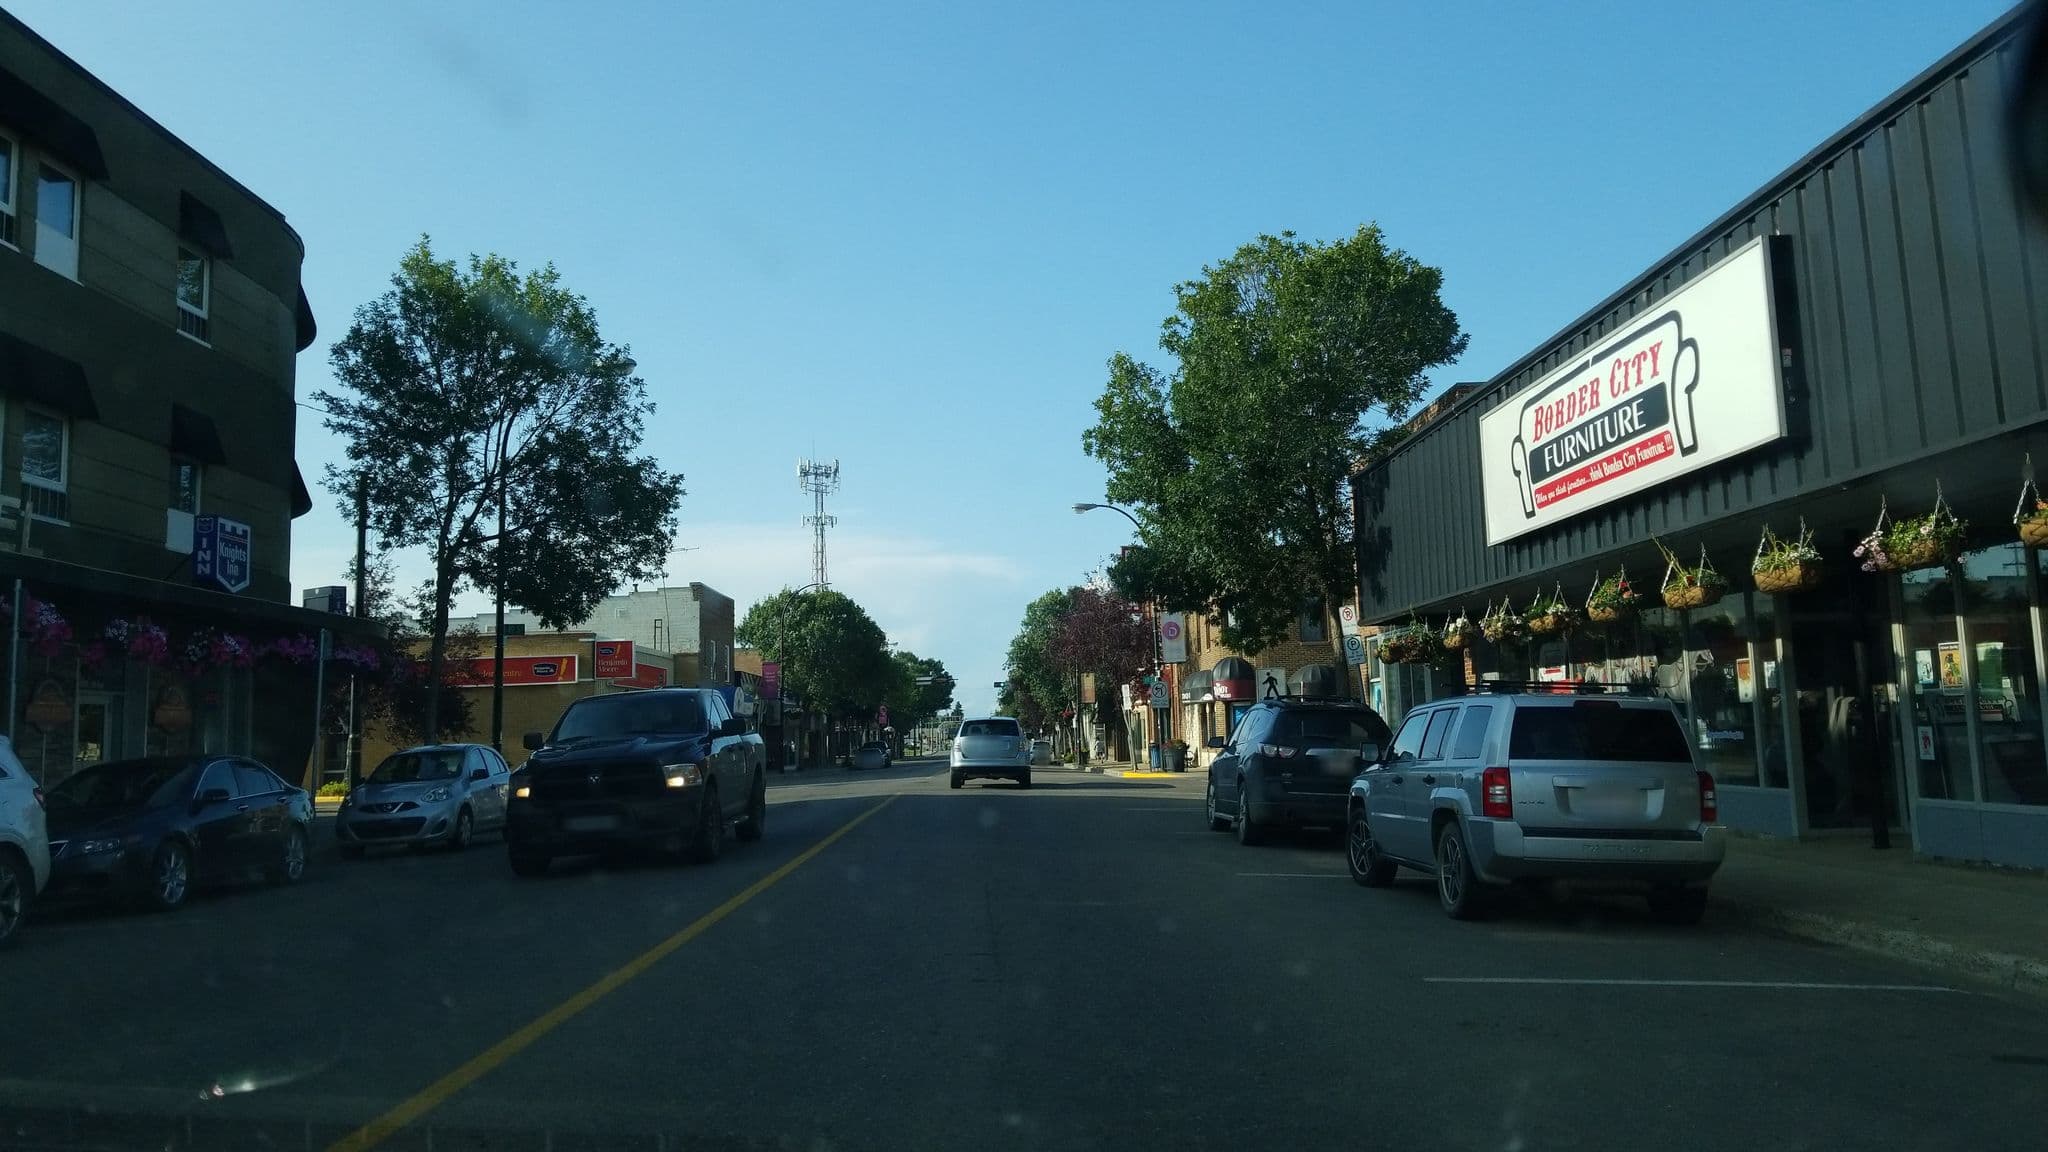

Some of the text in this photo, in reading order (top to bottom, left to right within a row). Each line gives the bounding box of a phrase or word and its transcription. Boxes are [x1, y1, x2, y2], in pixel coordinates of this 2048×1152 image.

[1533, 340, 1662, 443] BORDER CITY
[1544, 398, 1647, 473] FURNITURE
[197, 536, 211, 576] INN
[220, 542, 247, 563] Knights
[227, 559, 239, 577] Inn
